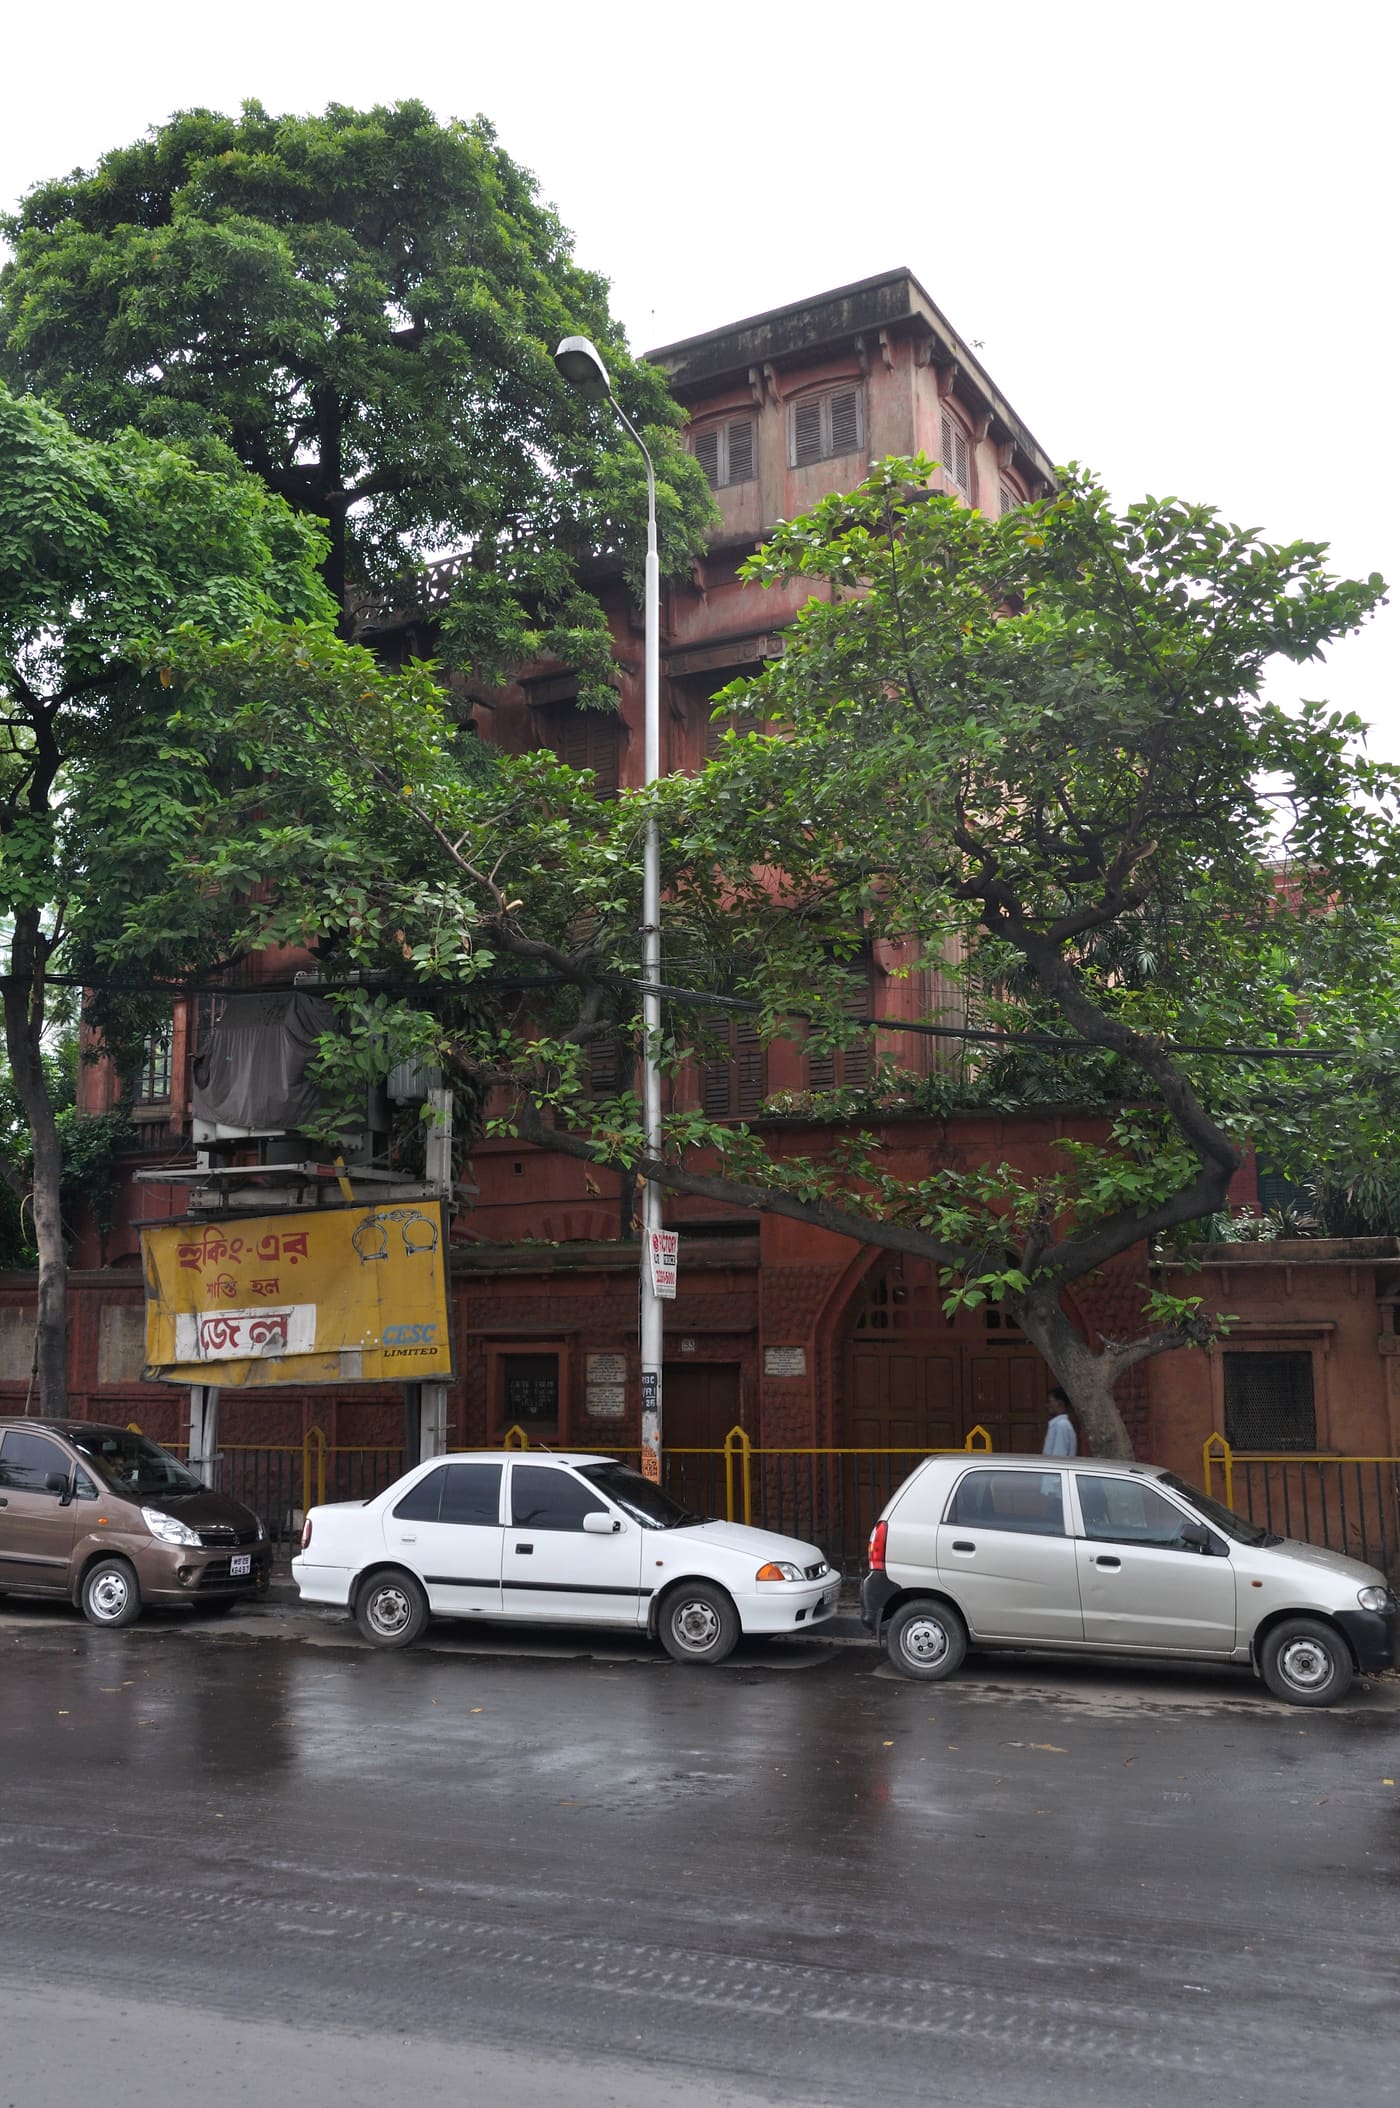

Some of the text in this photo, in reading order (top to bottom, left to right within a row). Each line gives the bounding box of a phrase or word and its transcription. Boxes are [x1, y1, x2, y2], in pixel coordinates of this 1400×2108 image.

[177, 1225, 309, 1273] হুকিং-এর
[206, 1273, 280, 1300] শাস্তি হল
[382, 1323, 437, 1345] CESC
[383, 1347, 438, 1357] LIMITED
